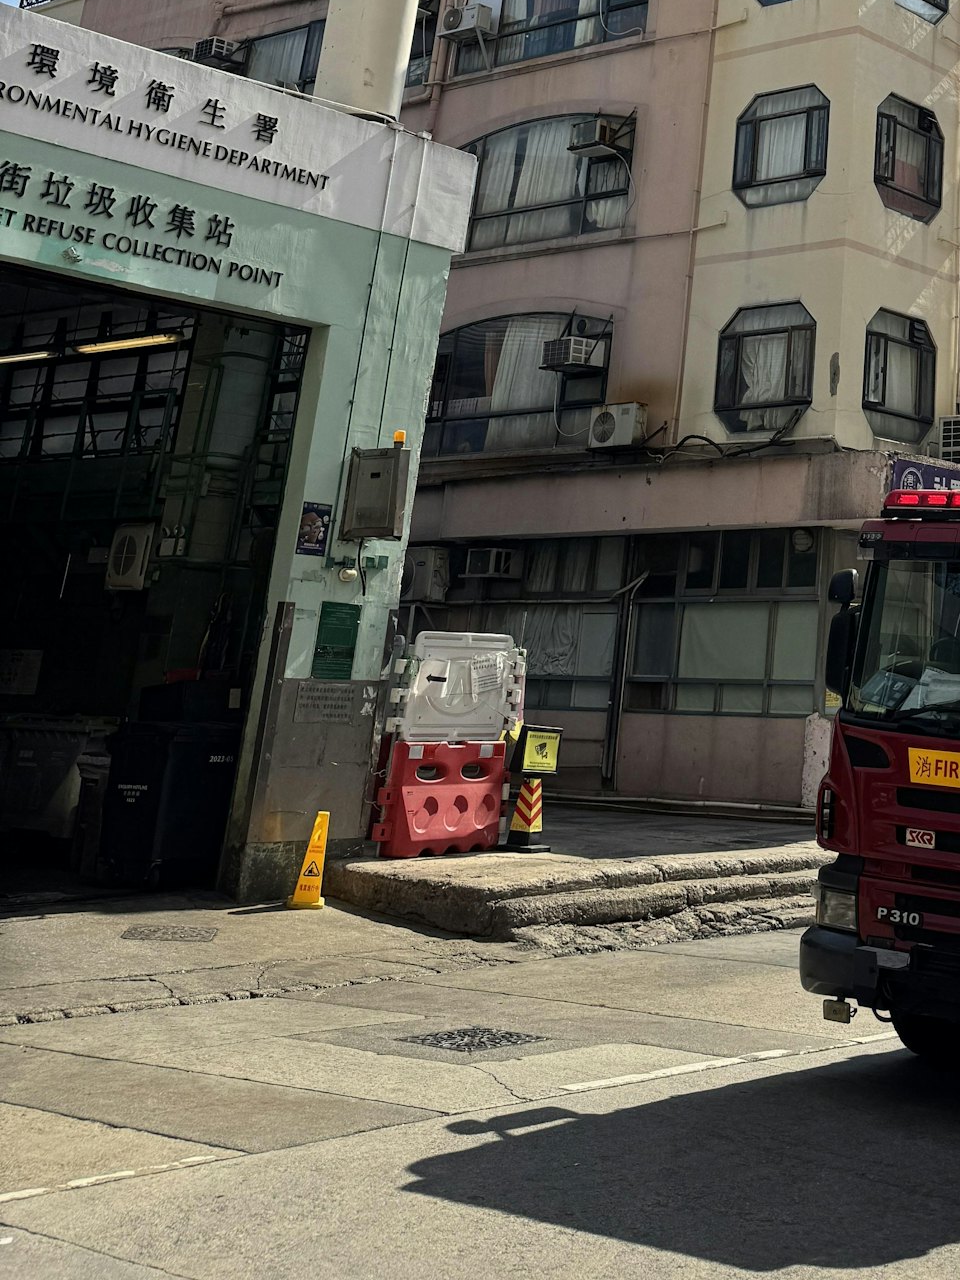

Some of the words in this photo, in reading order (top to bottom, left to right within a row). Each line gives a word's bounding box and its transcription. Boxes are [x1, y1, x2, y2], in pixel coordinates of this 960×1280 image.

[26, 43, 279, 144] 環境衛生署
[126, 119, 212, 157] HYGIENE
[214, 145, 330, 190] DEPARTMENT
[0, 160, 235, 248] 街垃圾收集站
[22, 213, 96, 245] REFUSE
[102, 232, 222, 274] COLLECTION
[227, 261, 284, 288] POINT
[877, 907, 888, 920] P
[889, 908, 920, 926] 310
